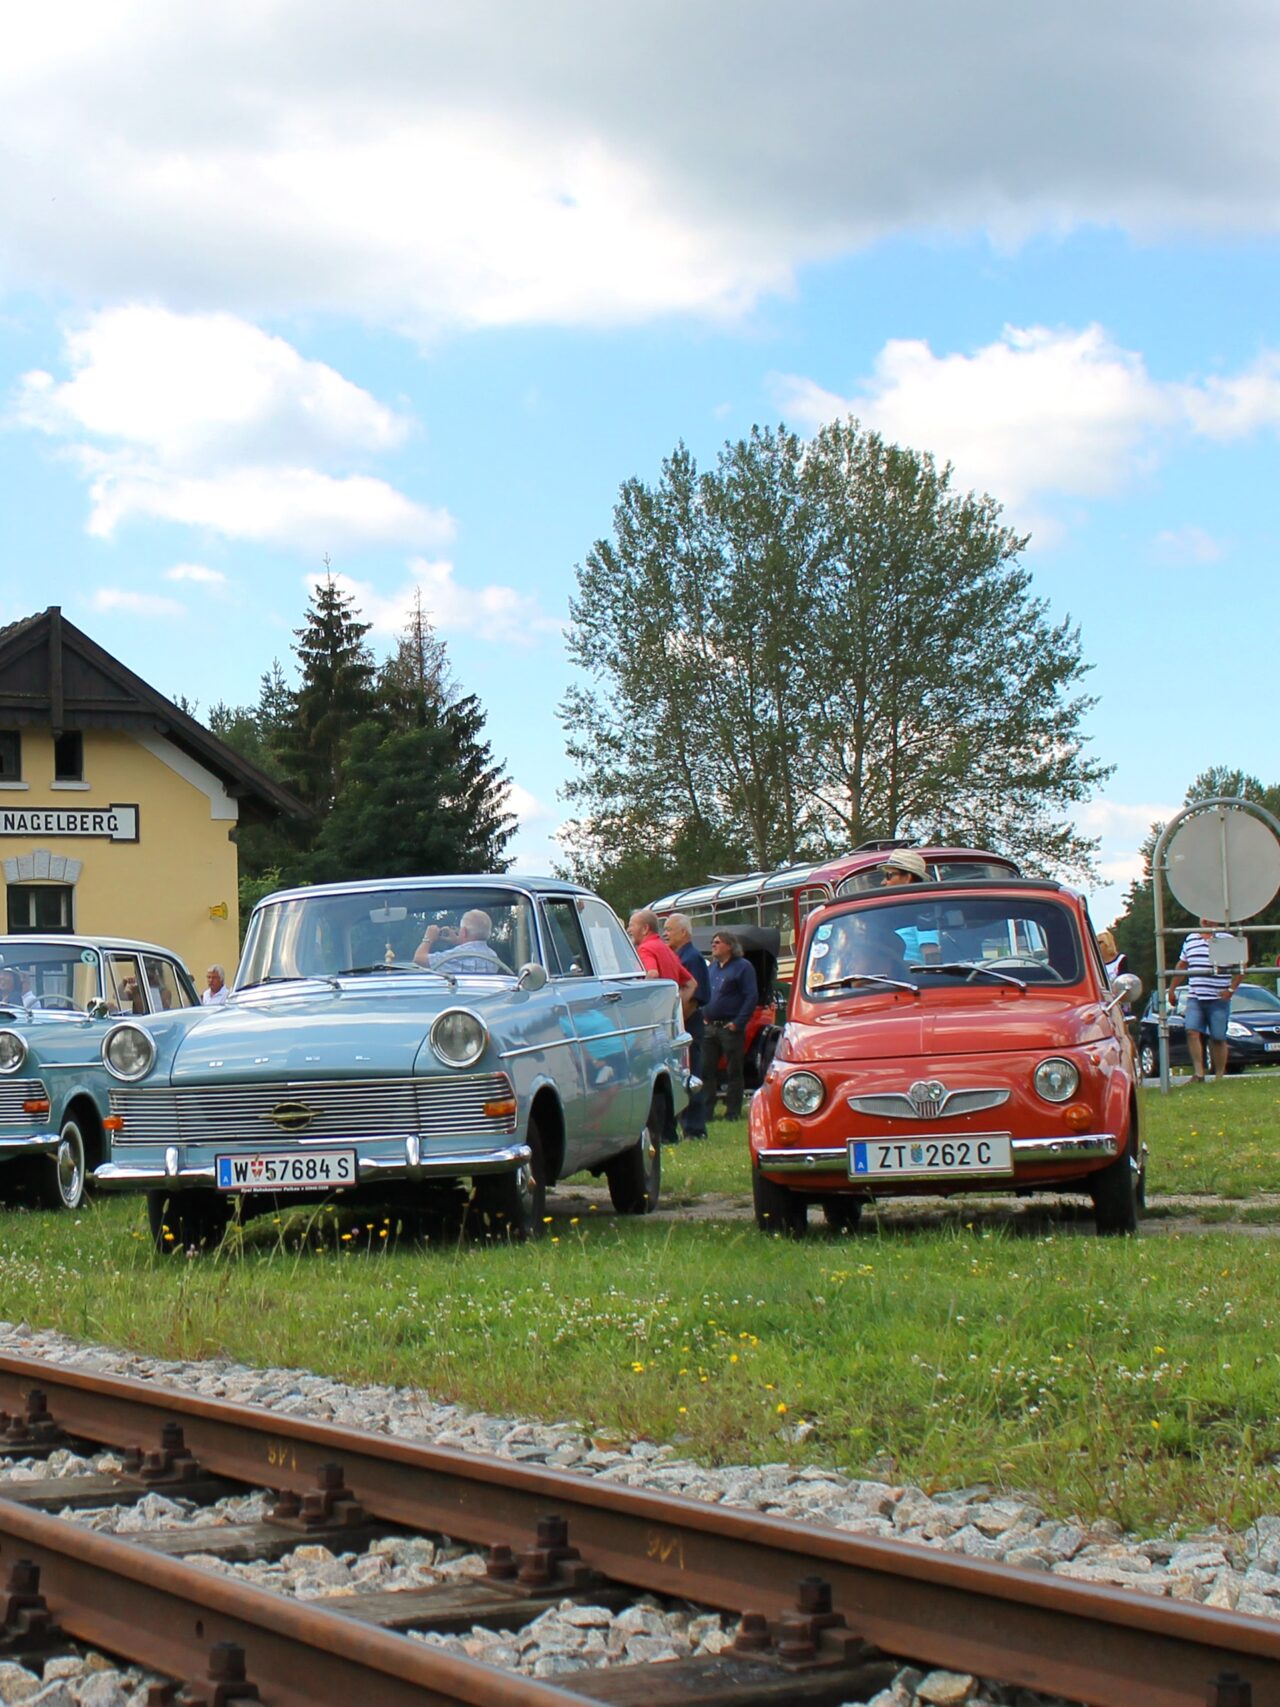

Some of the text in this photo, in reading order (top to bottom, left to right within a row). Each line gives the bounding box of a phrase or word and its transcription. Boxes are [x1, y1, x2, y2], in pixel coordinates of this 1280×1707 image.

[856, 1142, 991, 1169] A ZT 262 C
[222, 1157, 349, 1183] A W 57684 S
